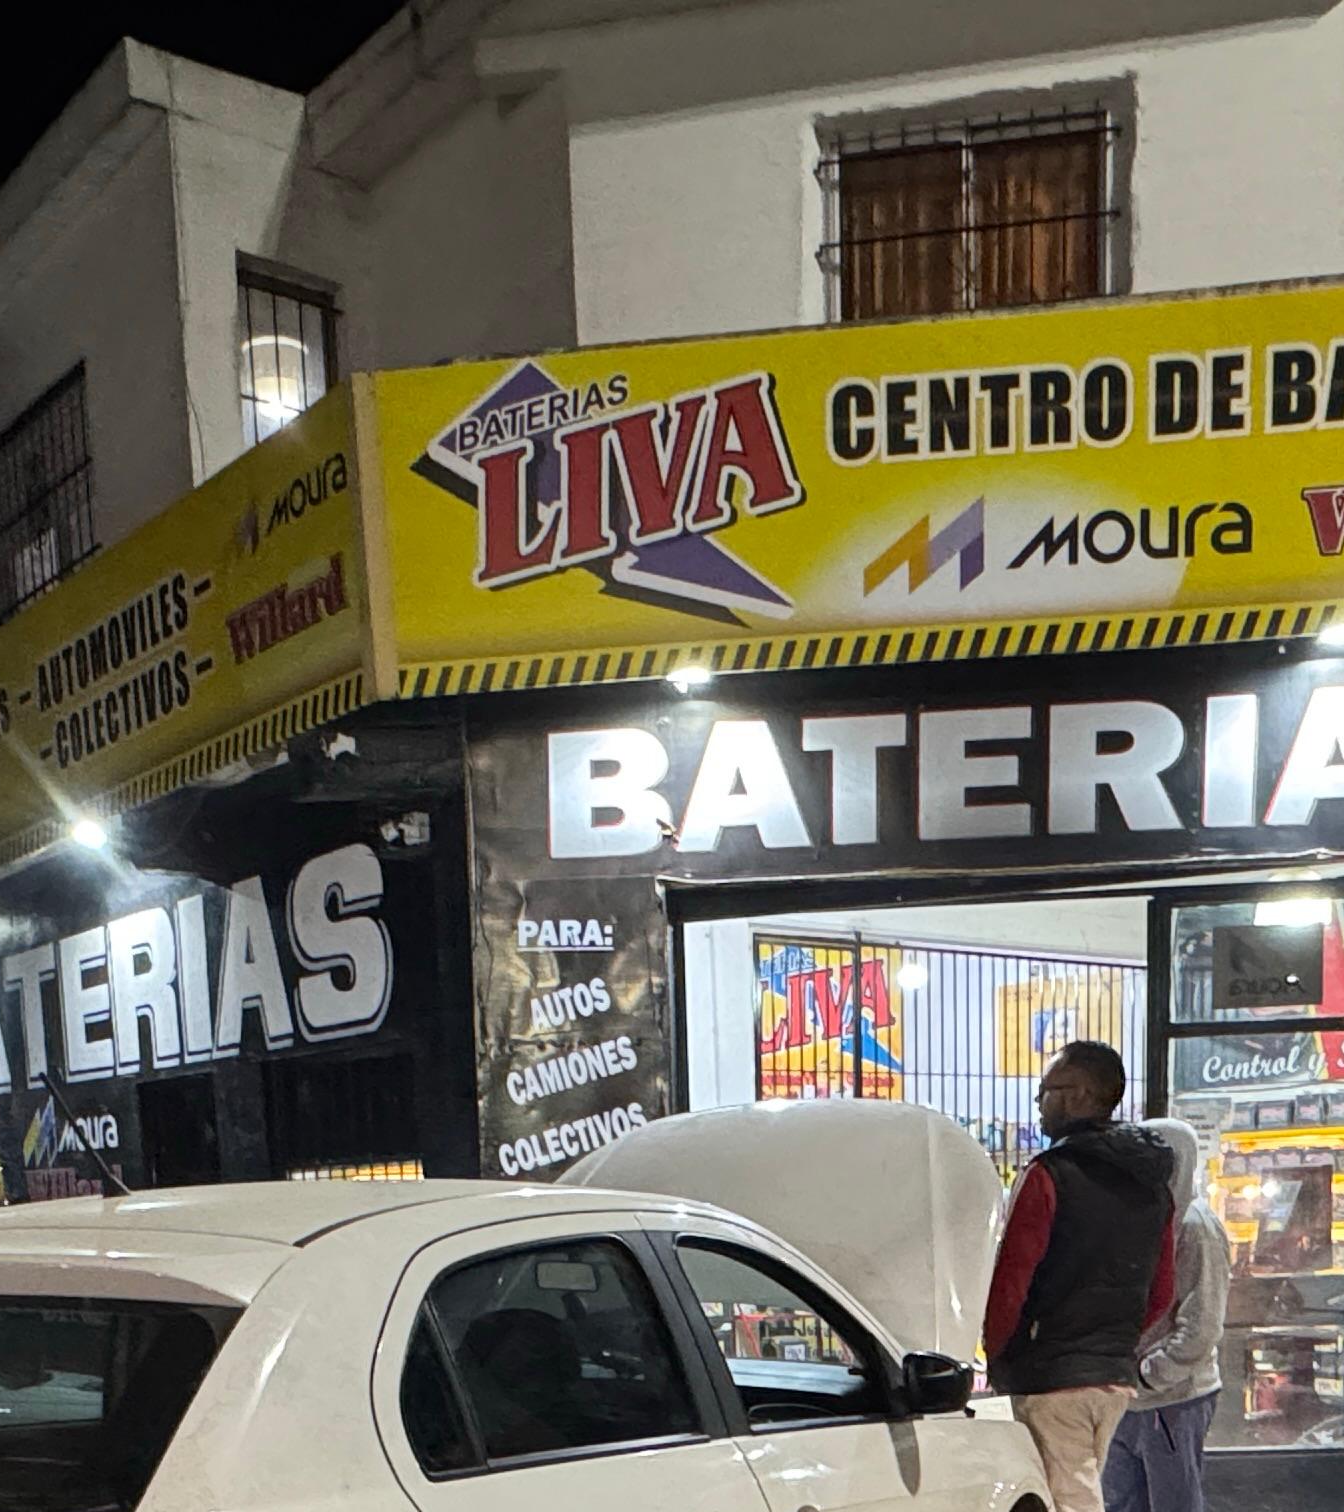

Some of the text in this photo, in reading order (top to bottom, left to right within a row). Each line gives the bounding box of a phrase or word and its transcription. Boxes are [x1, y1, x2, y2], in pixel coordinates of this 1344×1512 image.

[458, 374, 629, 453] BATERIAS
[828, 358, 1132, 464] CENTRO
[1153, 350, 1248, 441] DE
[475, 374, 800, 586] LIVA
[228, 551, 346, 666] Willard
[517, 918, 614, 947] PARA:
[529, 976, 611, 1031] AUTOS
[506, 1036, 638, 1106] CAMIONES
[1202, 1044, 1300, 1083] Control
[498, 1101, 650, 1178] COLECTIVOS
